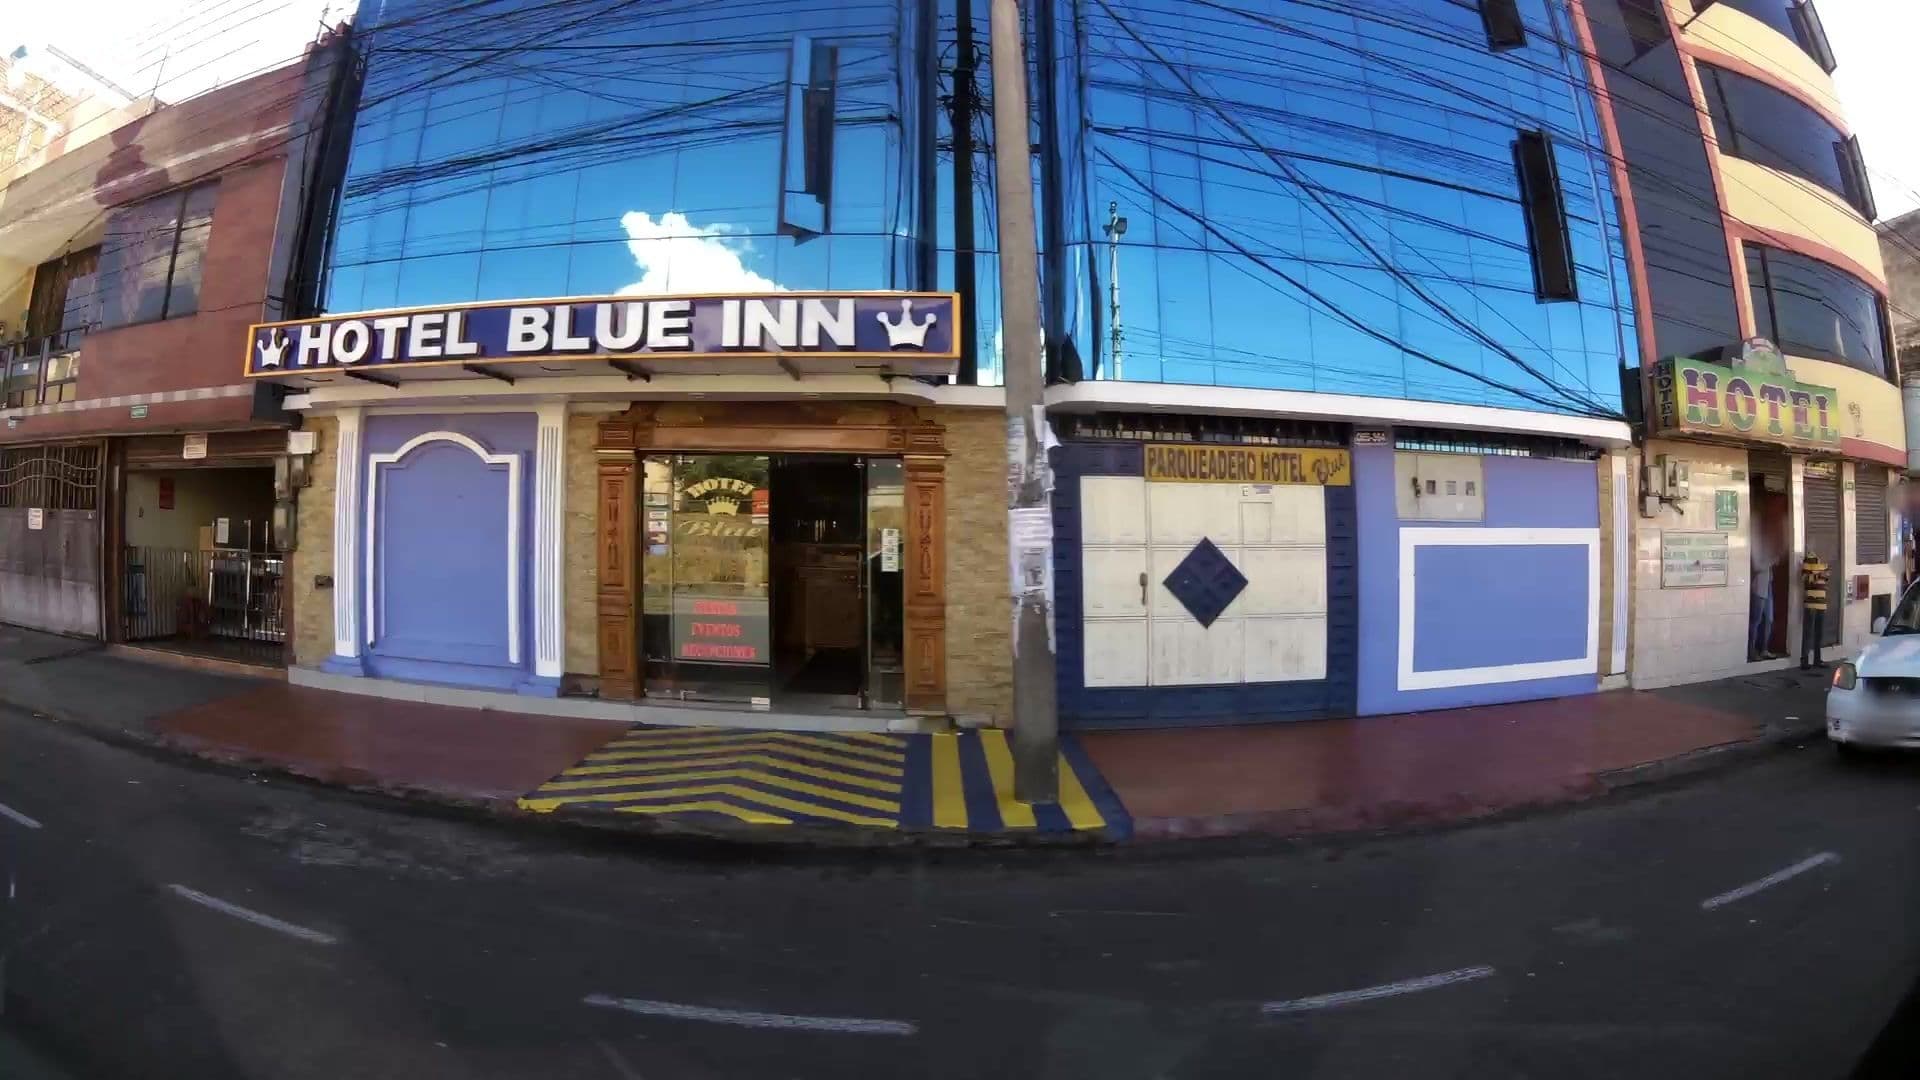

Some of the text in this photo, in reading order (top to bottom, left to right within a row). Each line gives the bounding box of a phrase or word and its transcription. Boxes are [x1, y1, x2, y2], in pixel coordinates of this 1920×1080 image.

[297, 298, 855, 366] HOTEL BLUE INN
[1681, 367, 1839, 443] HOTEL
[1147, 447, 1256, 481] PARQUEADERO
[1261, 451, 1307, 482] HOTEL
